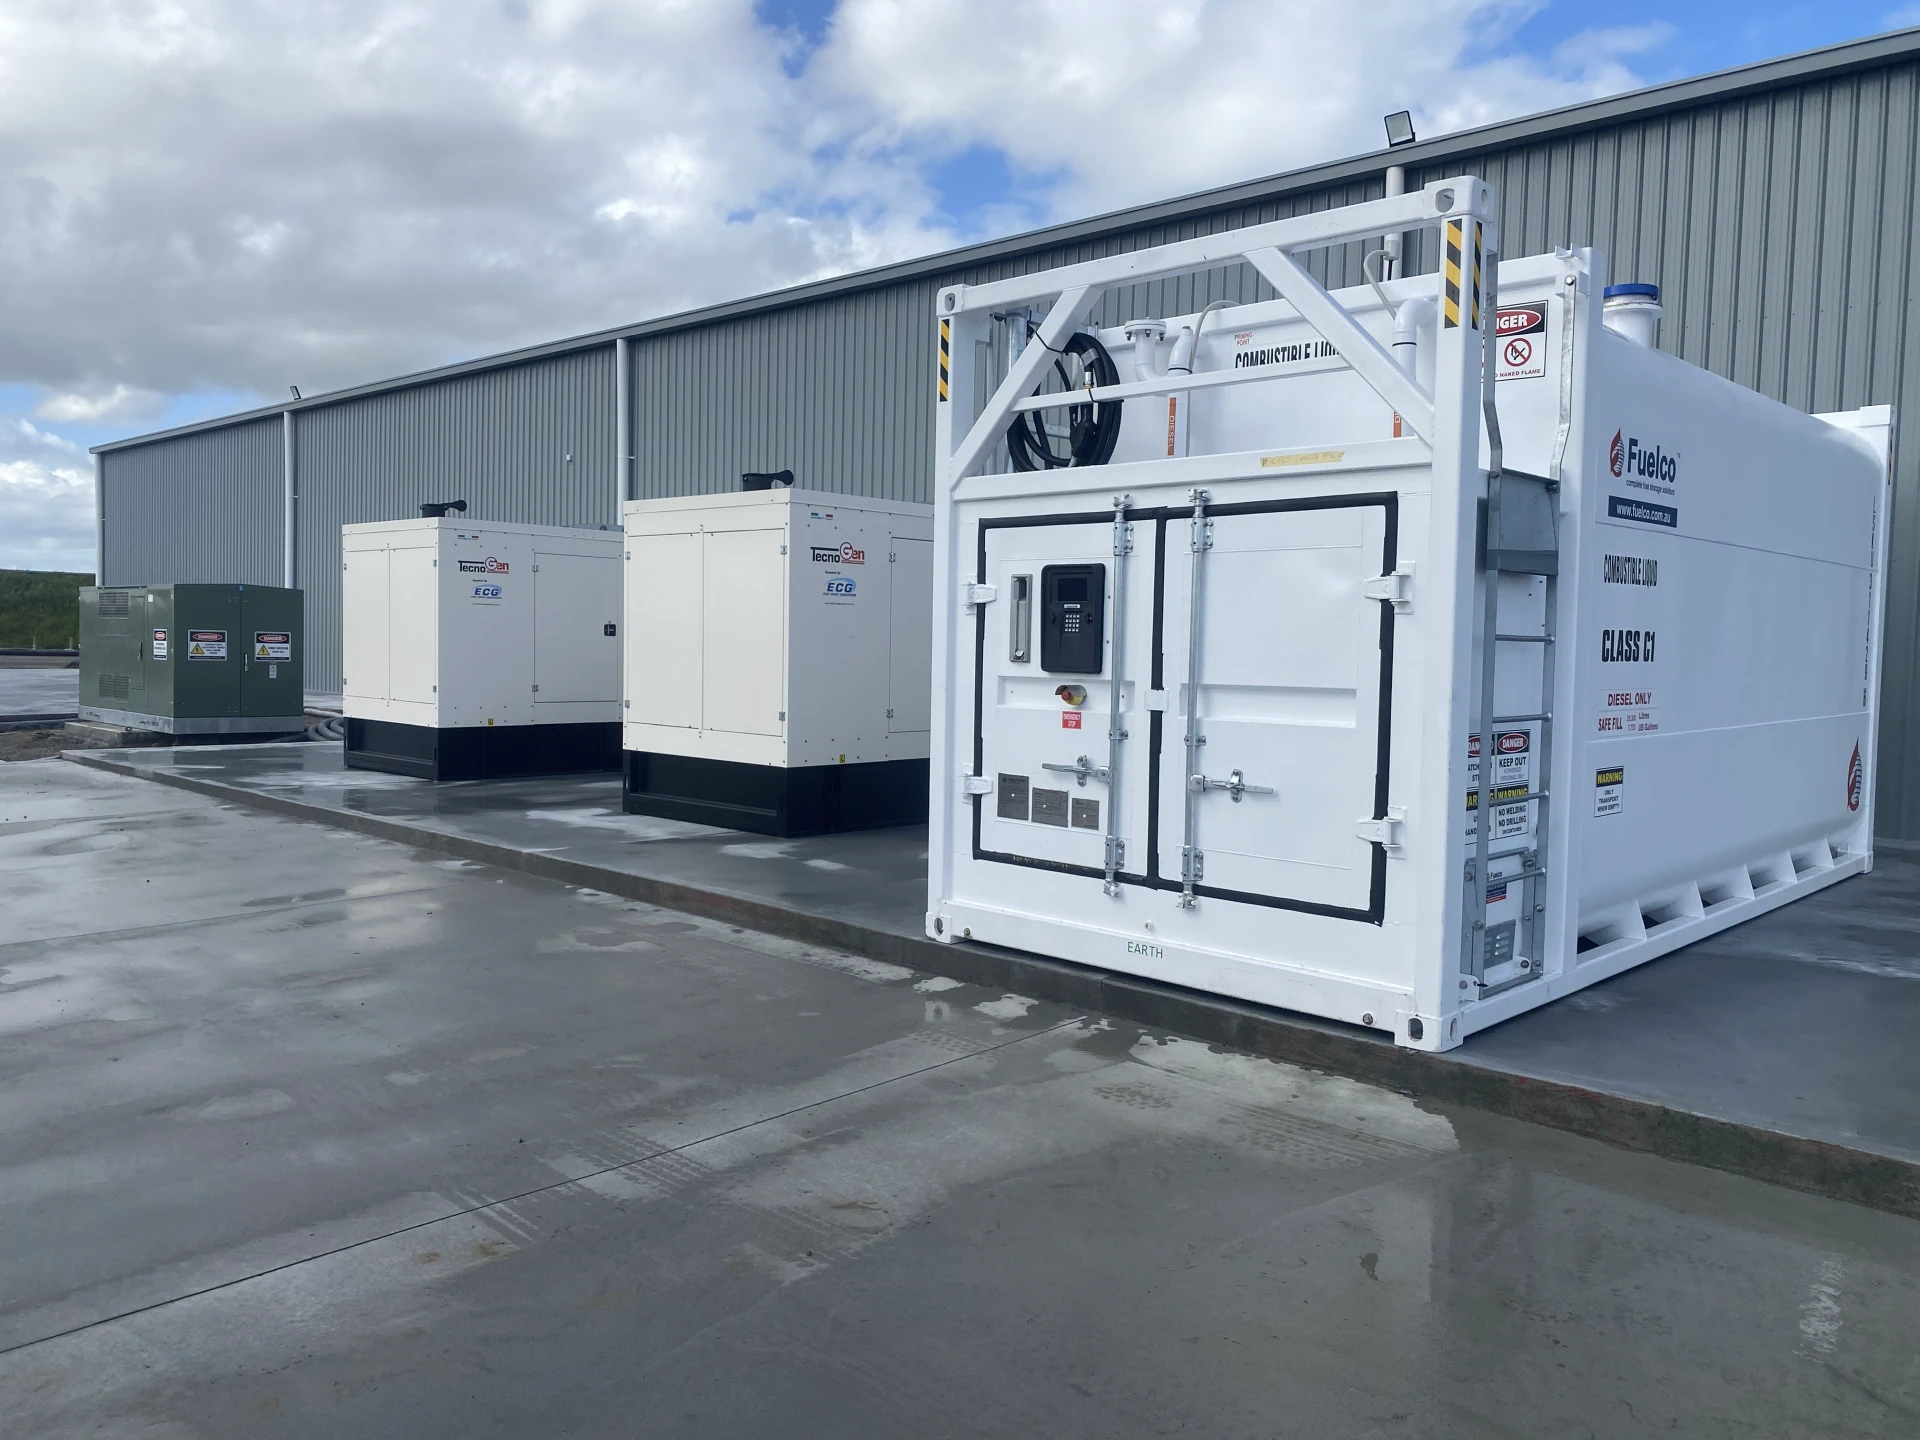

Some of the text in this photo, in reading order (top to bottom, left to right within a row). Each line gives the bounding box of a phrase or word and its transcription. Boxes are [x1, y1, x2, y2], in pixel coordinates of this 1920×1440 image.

[1496, 314, 1528, 330] GER
[1236, 338, 1250, 346] POINT
[1499, 370, 1520, 378] NAKED
[1627, 437, 1676, 483] Fuelco
[1626, 479, 1643, 489] complete
[1616, 503, 1671, 524] www.fuelco.com.au
[1603, 553, 1641, 586] COMBUSTIBLE
[474, 587, 499, 597] ECG
[827, 582, 853, 593] ECG
[197, 632, 218, 640] DANGER
[1601, 629, 1656, 663] CLASS C1
[1607, 691, 1652, 707] DIESEL ONLY
[1598, 717, 1611, 732] SAFE
[1611, 716, 1623, 730] FILL
[1502, 737, 1524, 749] DANGER
[1498, 757, 1514, 769] KEEP
[1514, 756, 1527, 767] OUT
[1597, 771, 1623, 785] WARNING
[1598, 795, 1619, 805] TRANSPORT
[1498, 804, 1527, 817] NO WELDING
[1608, 803, 1620, 811] EMPTY
[1498, 815, 1527, 828] NO DRILLING
[1127, 941, 1164, 959] EARTH
